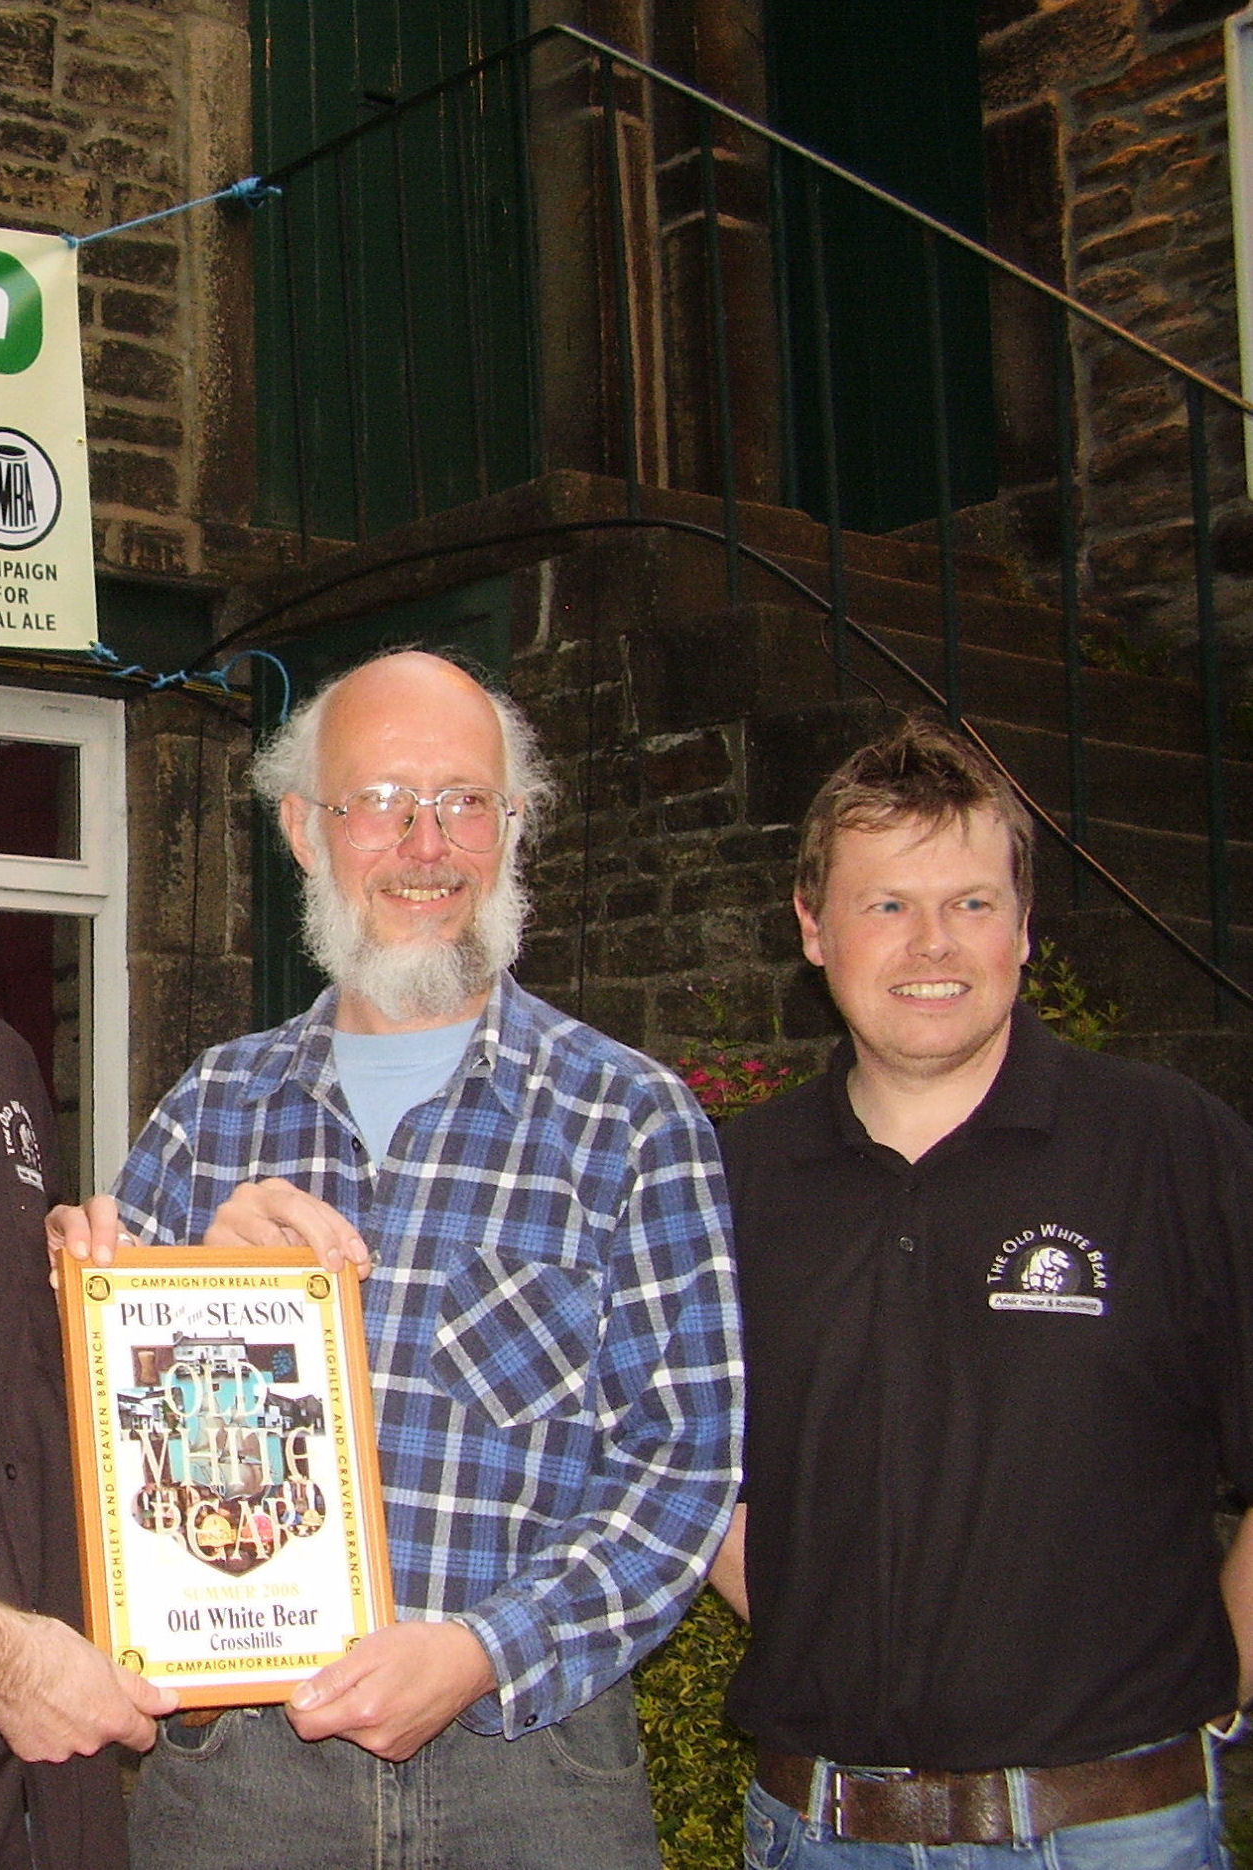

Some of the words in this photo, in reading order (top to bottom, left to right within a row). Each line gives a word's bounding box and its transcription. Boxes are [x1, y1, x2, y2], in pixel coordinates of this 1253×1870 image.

[22, 612, 57, 632] ALE
[986, 1254, 1010, 1286] THE
[1002, 1229, 1036, 1254] OLD
[1039, 1223, 1091, 1251] WHITE
[1086, 1250, 1108, 1290] BEAR
[130, 1276, 199, 1289] CAMPAIGN
[202, 1276, 226, 1288] FOR
[228, 1276, 257, 1288] REAL
[259, 1276, 280, 1288] ALE
[120, 1302, 173, 1327] PUB
[206, 1301, 305, 1327] SEASON
[92, 1331, 107, 1396] BRANCH
[324, 1328, 340, 1404] KEIGHLEY
[164, 1361, 268, 1418] OLD
[99, 1407, 114, 1473] CRAVEN
[334, 1413, 345, 1446] AND
[105, 1484, 117, 1517] AND
[338, 1455, 353, 1520] CRAVEN
[109, 1529, 124, 1608] KEIGHLEY
[346, 1529, 361, 1596] BRANCH
[168, 1609, 201, 1632] Old
[207, 1606, 266, 1630] White
[272, 1604, 318, 1627] Bear
[165, 1659, 237, 1673] CAMPAIGN
[239, 1657, 263, 1669] FOR
[266, 1655, 296, 1667] REAL
[298, 1654, 319, 1666] ALE
[210, 1631, 283, 1651] Crosshills
